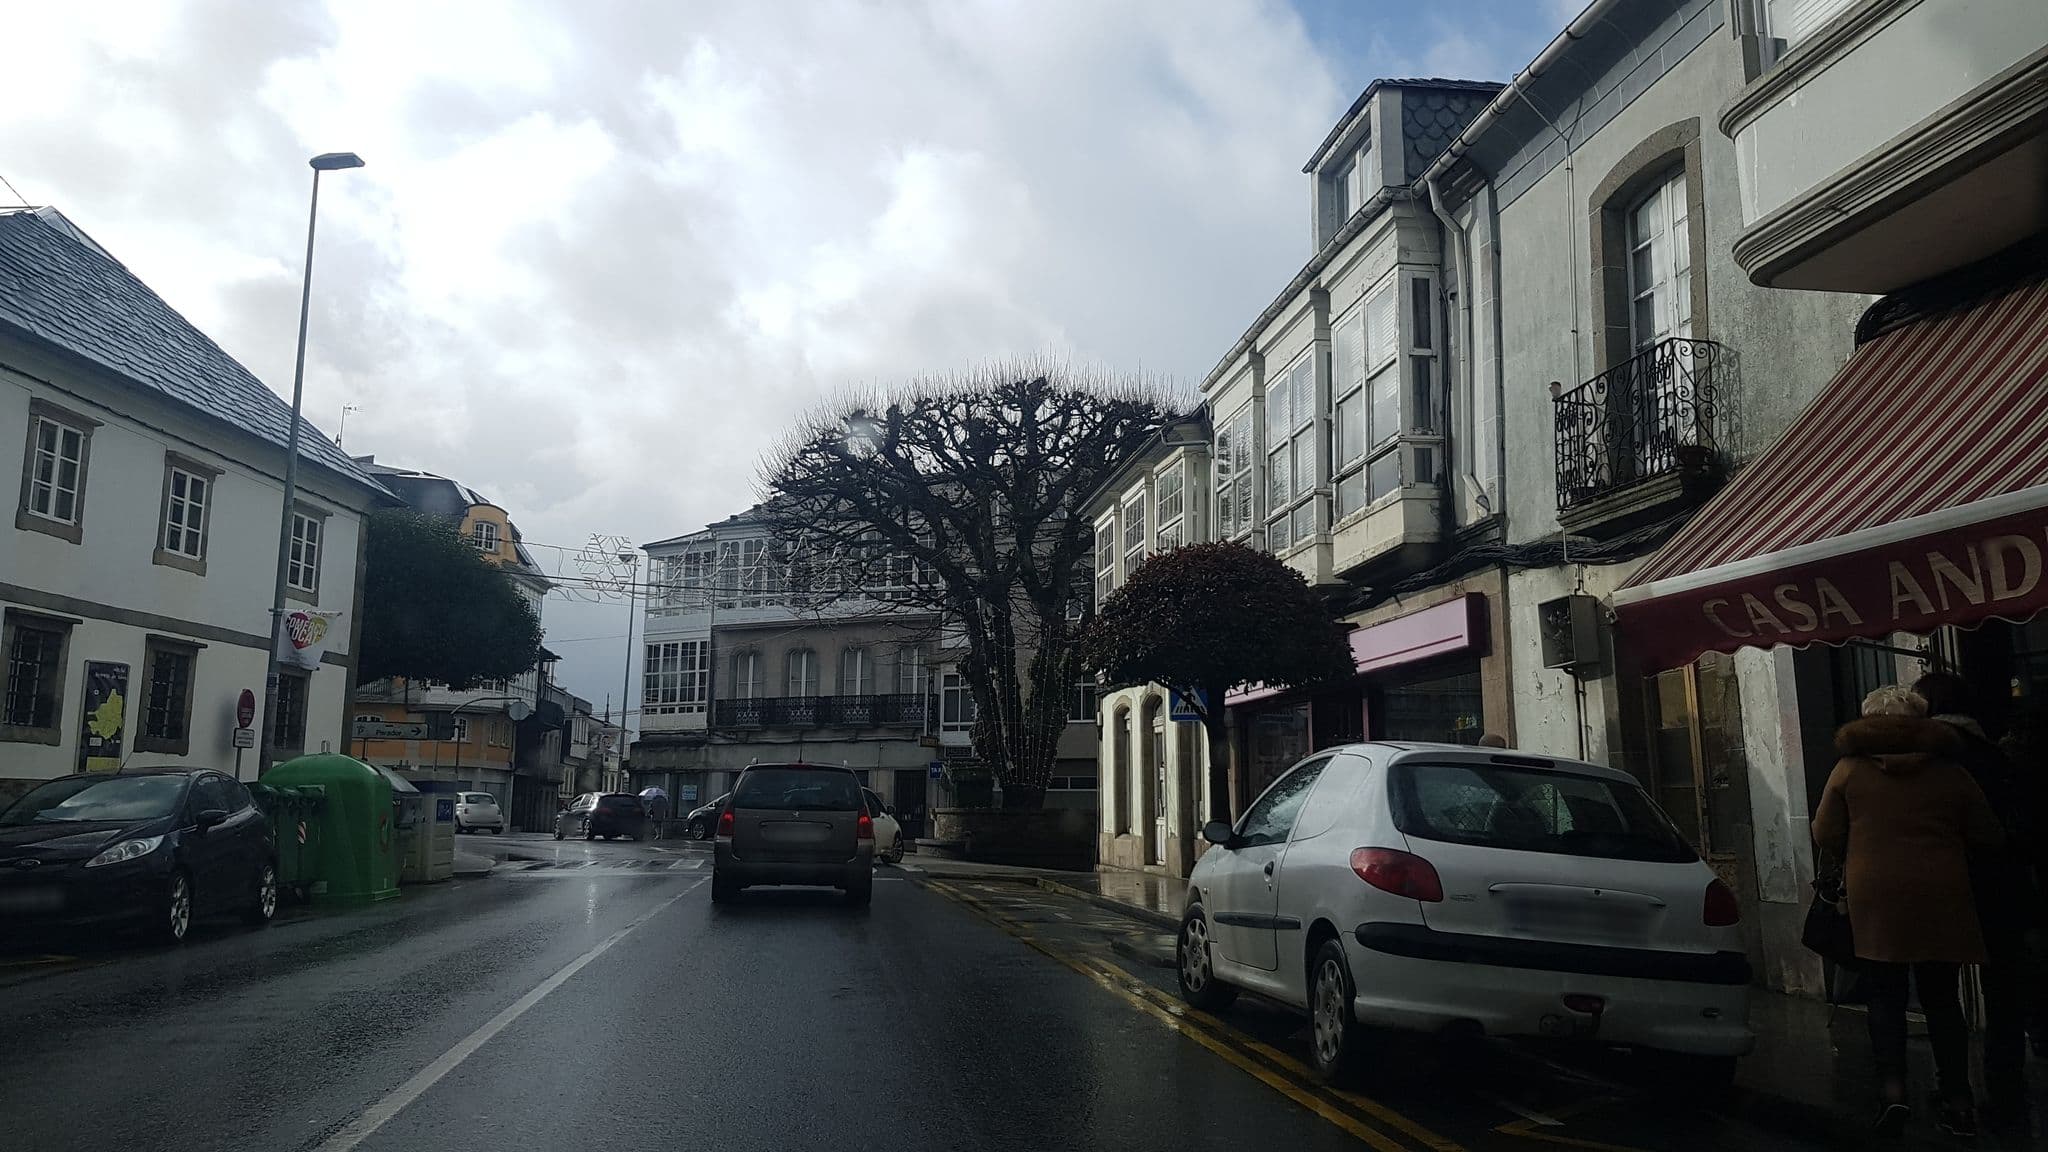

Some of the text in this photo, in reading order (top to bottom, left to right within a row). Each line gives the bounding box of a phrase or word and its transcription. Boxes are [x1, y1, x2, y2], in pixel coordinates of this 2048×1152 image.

[1702, 526, 2048, 638] CASA AND
[286, 616, 328, 639] COMERCIO
[375, 729, 402, 737] Parador
